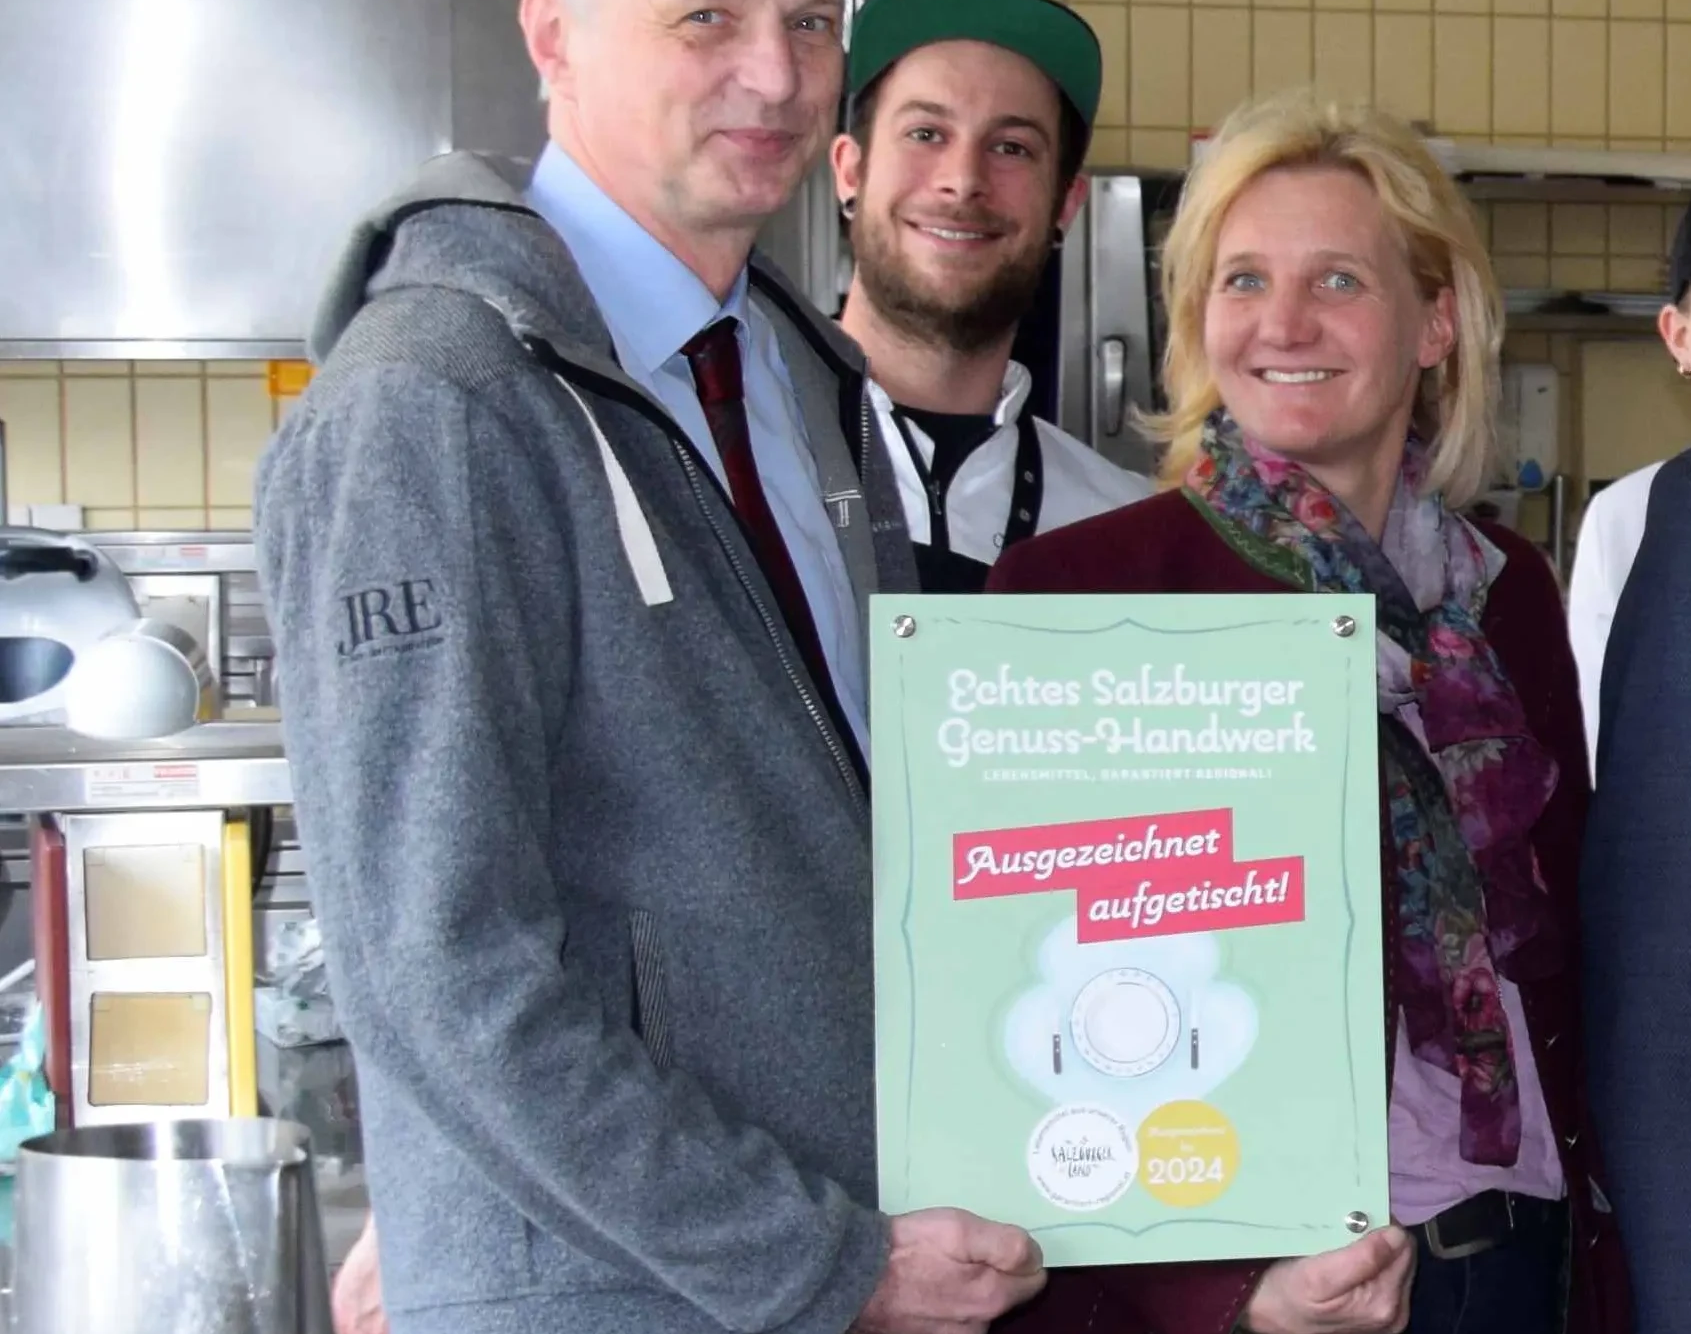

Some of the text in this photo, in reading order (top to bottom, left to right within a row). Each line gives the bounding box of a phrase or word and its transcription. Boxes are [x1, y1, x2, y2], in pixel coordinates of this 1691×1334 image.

[825, 489, 861, 527] T
[338, 578, 442, 655] JRE
[947, 663, 1304, 717] Echtes Salzburger
[937, 711, 1318, 768] Genuss-Handwerk
[957, 824, 1222, 885] Ausgezeichnet
[1088, 870, 1290, 929] aufgetischt!
[1147, 1156, 1224, 1185] 2024
